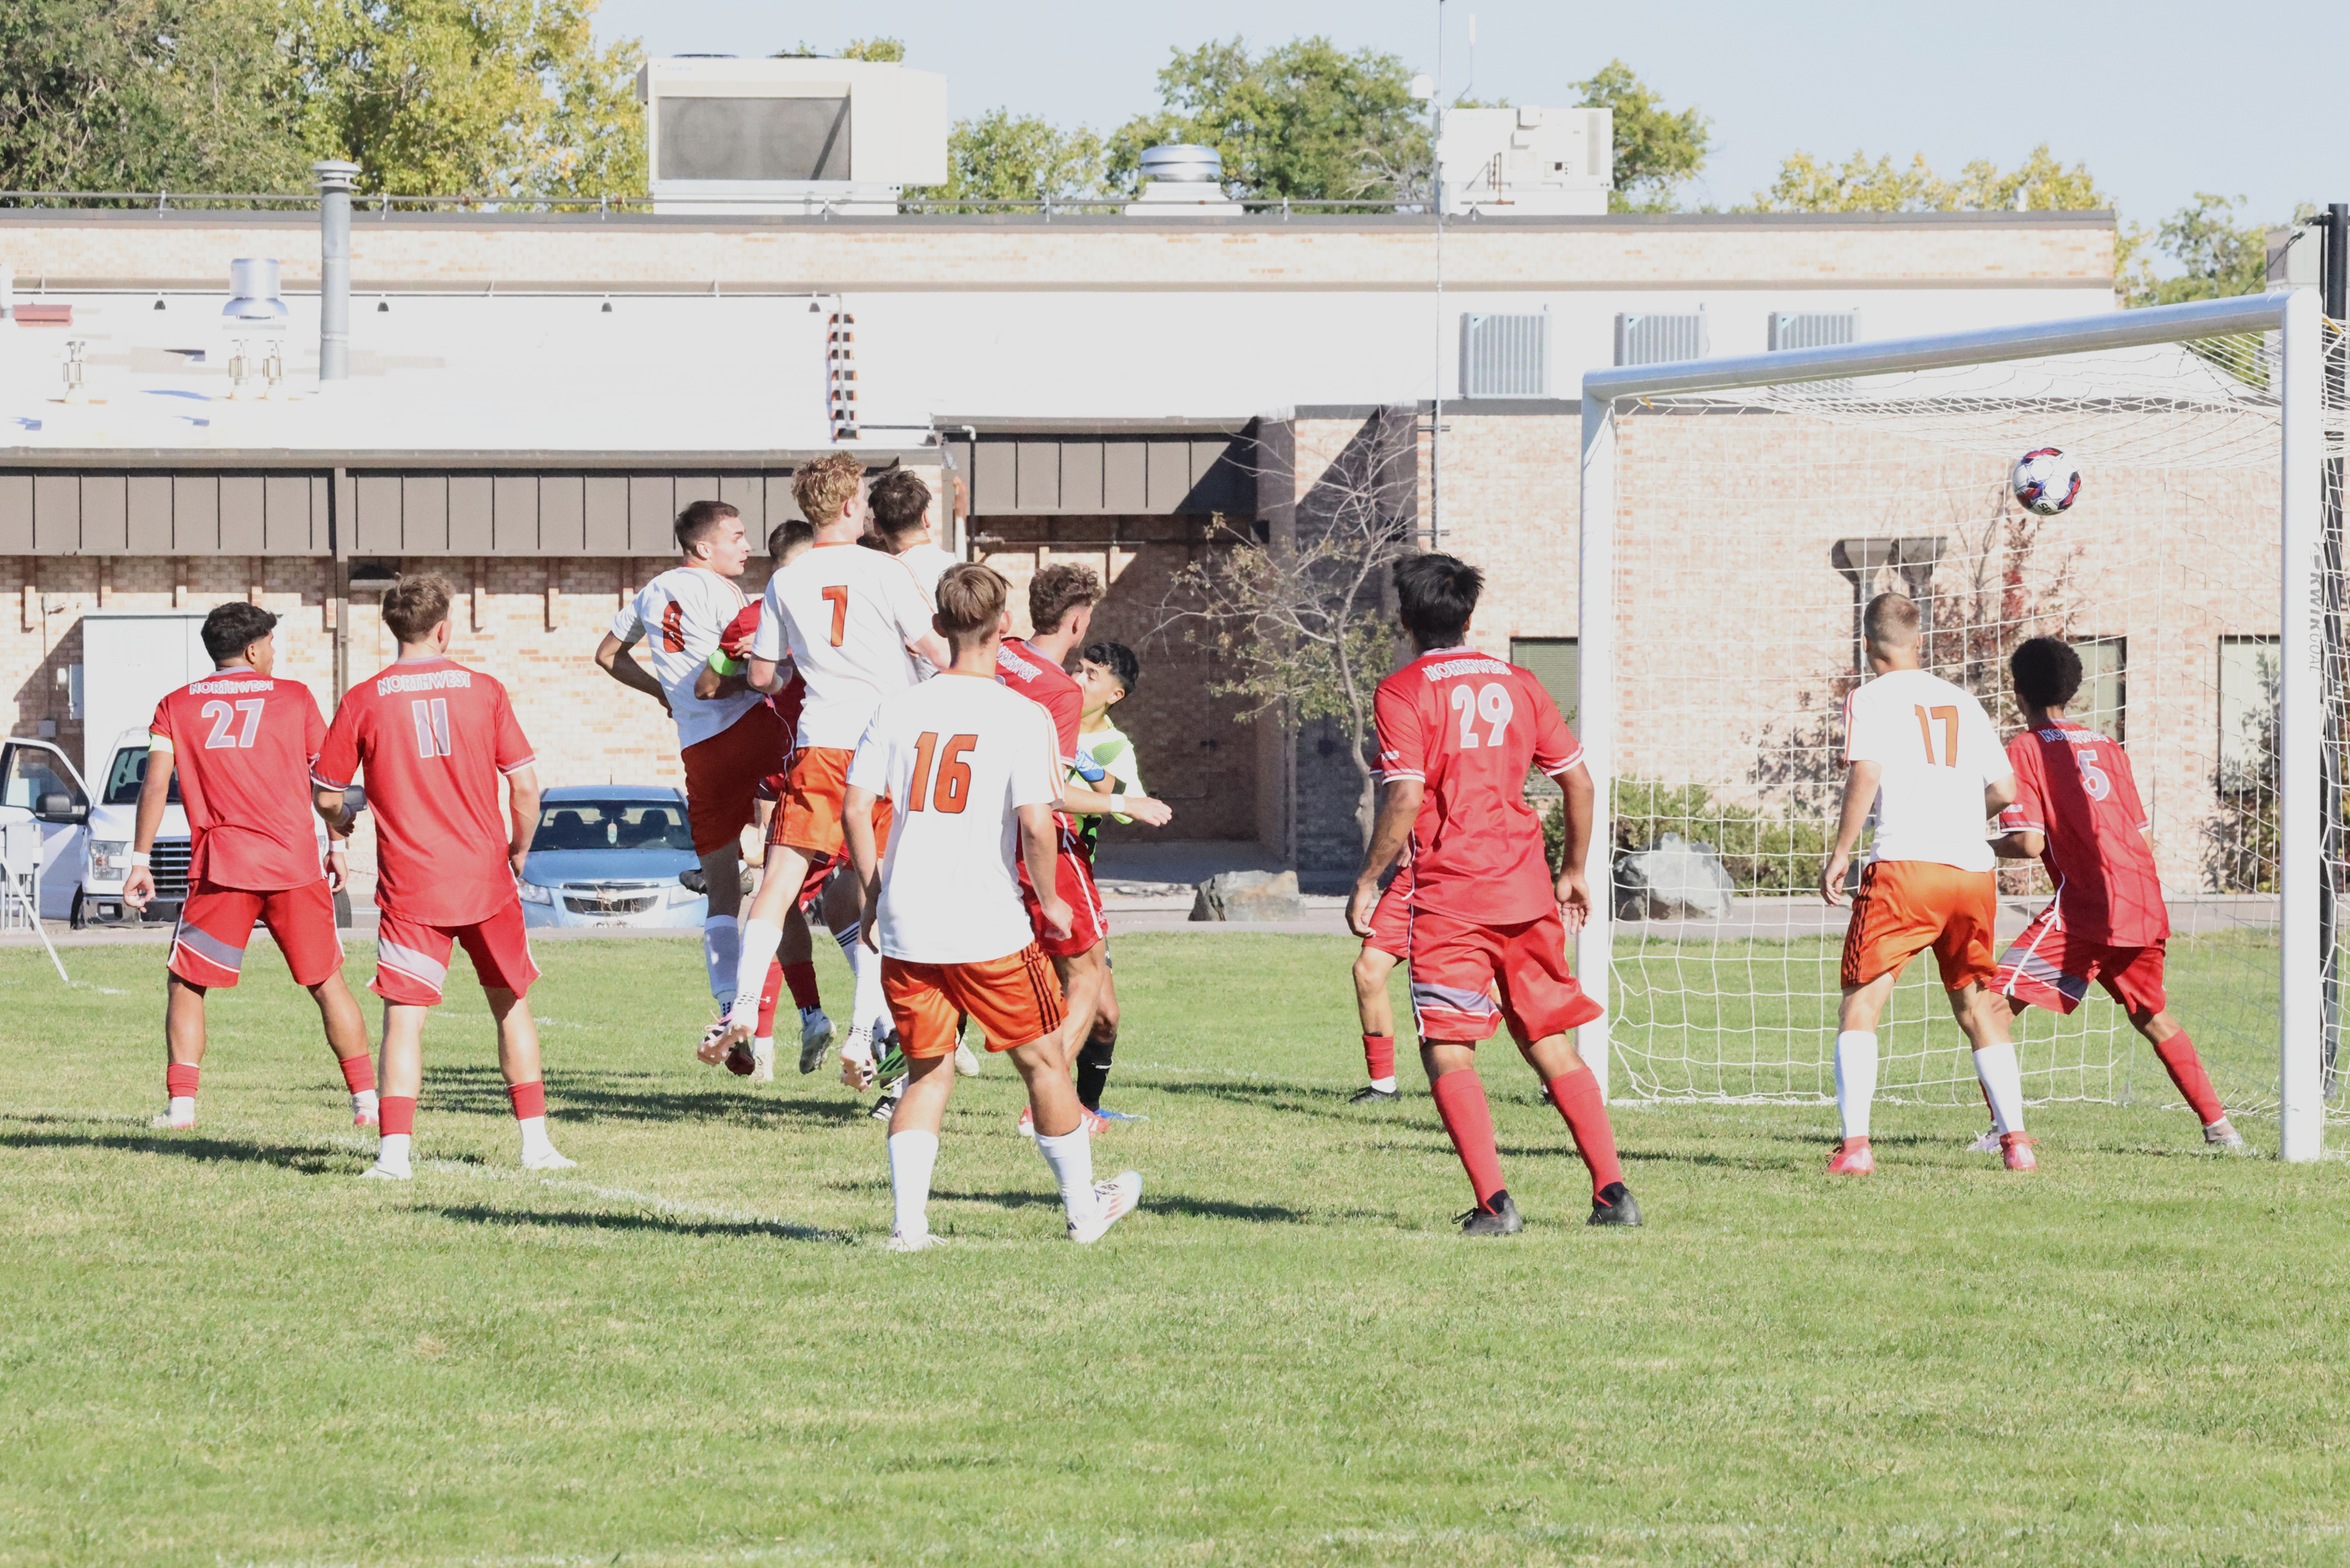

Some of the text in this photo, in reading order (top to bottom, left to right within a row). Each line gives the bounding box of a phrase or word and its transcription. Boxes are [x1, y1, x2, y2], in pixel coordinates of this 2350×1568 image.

[821, 585, 848, 647] 7
[377, 670, 471, 696] NORTHWEST
[1422, 658, 1512, 682] NORTHWEST
[201, 698, 265, 749] 27
[411, 698, 451, 758] 11
[1451, 682, 1514, 749] 29
[1914, 704, 1959, 768] 17
[909, 731, 979, 814] 16
[2077, 749, 2110, 801] 5
